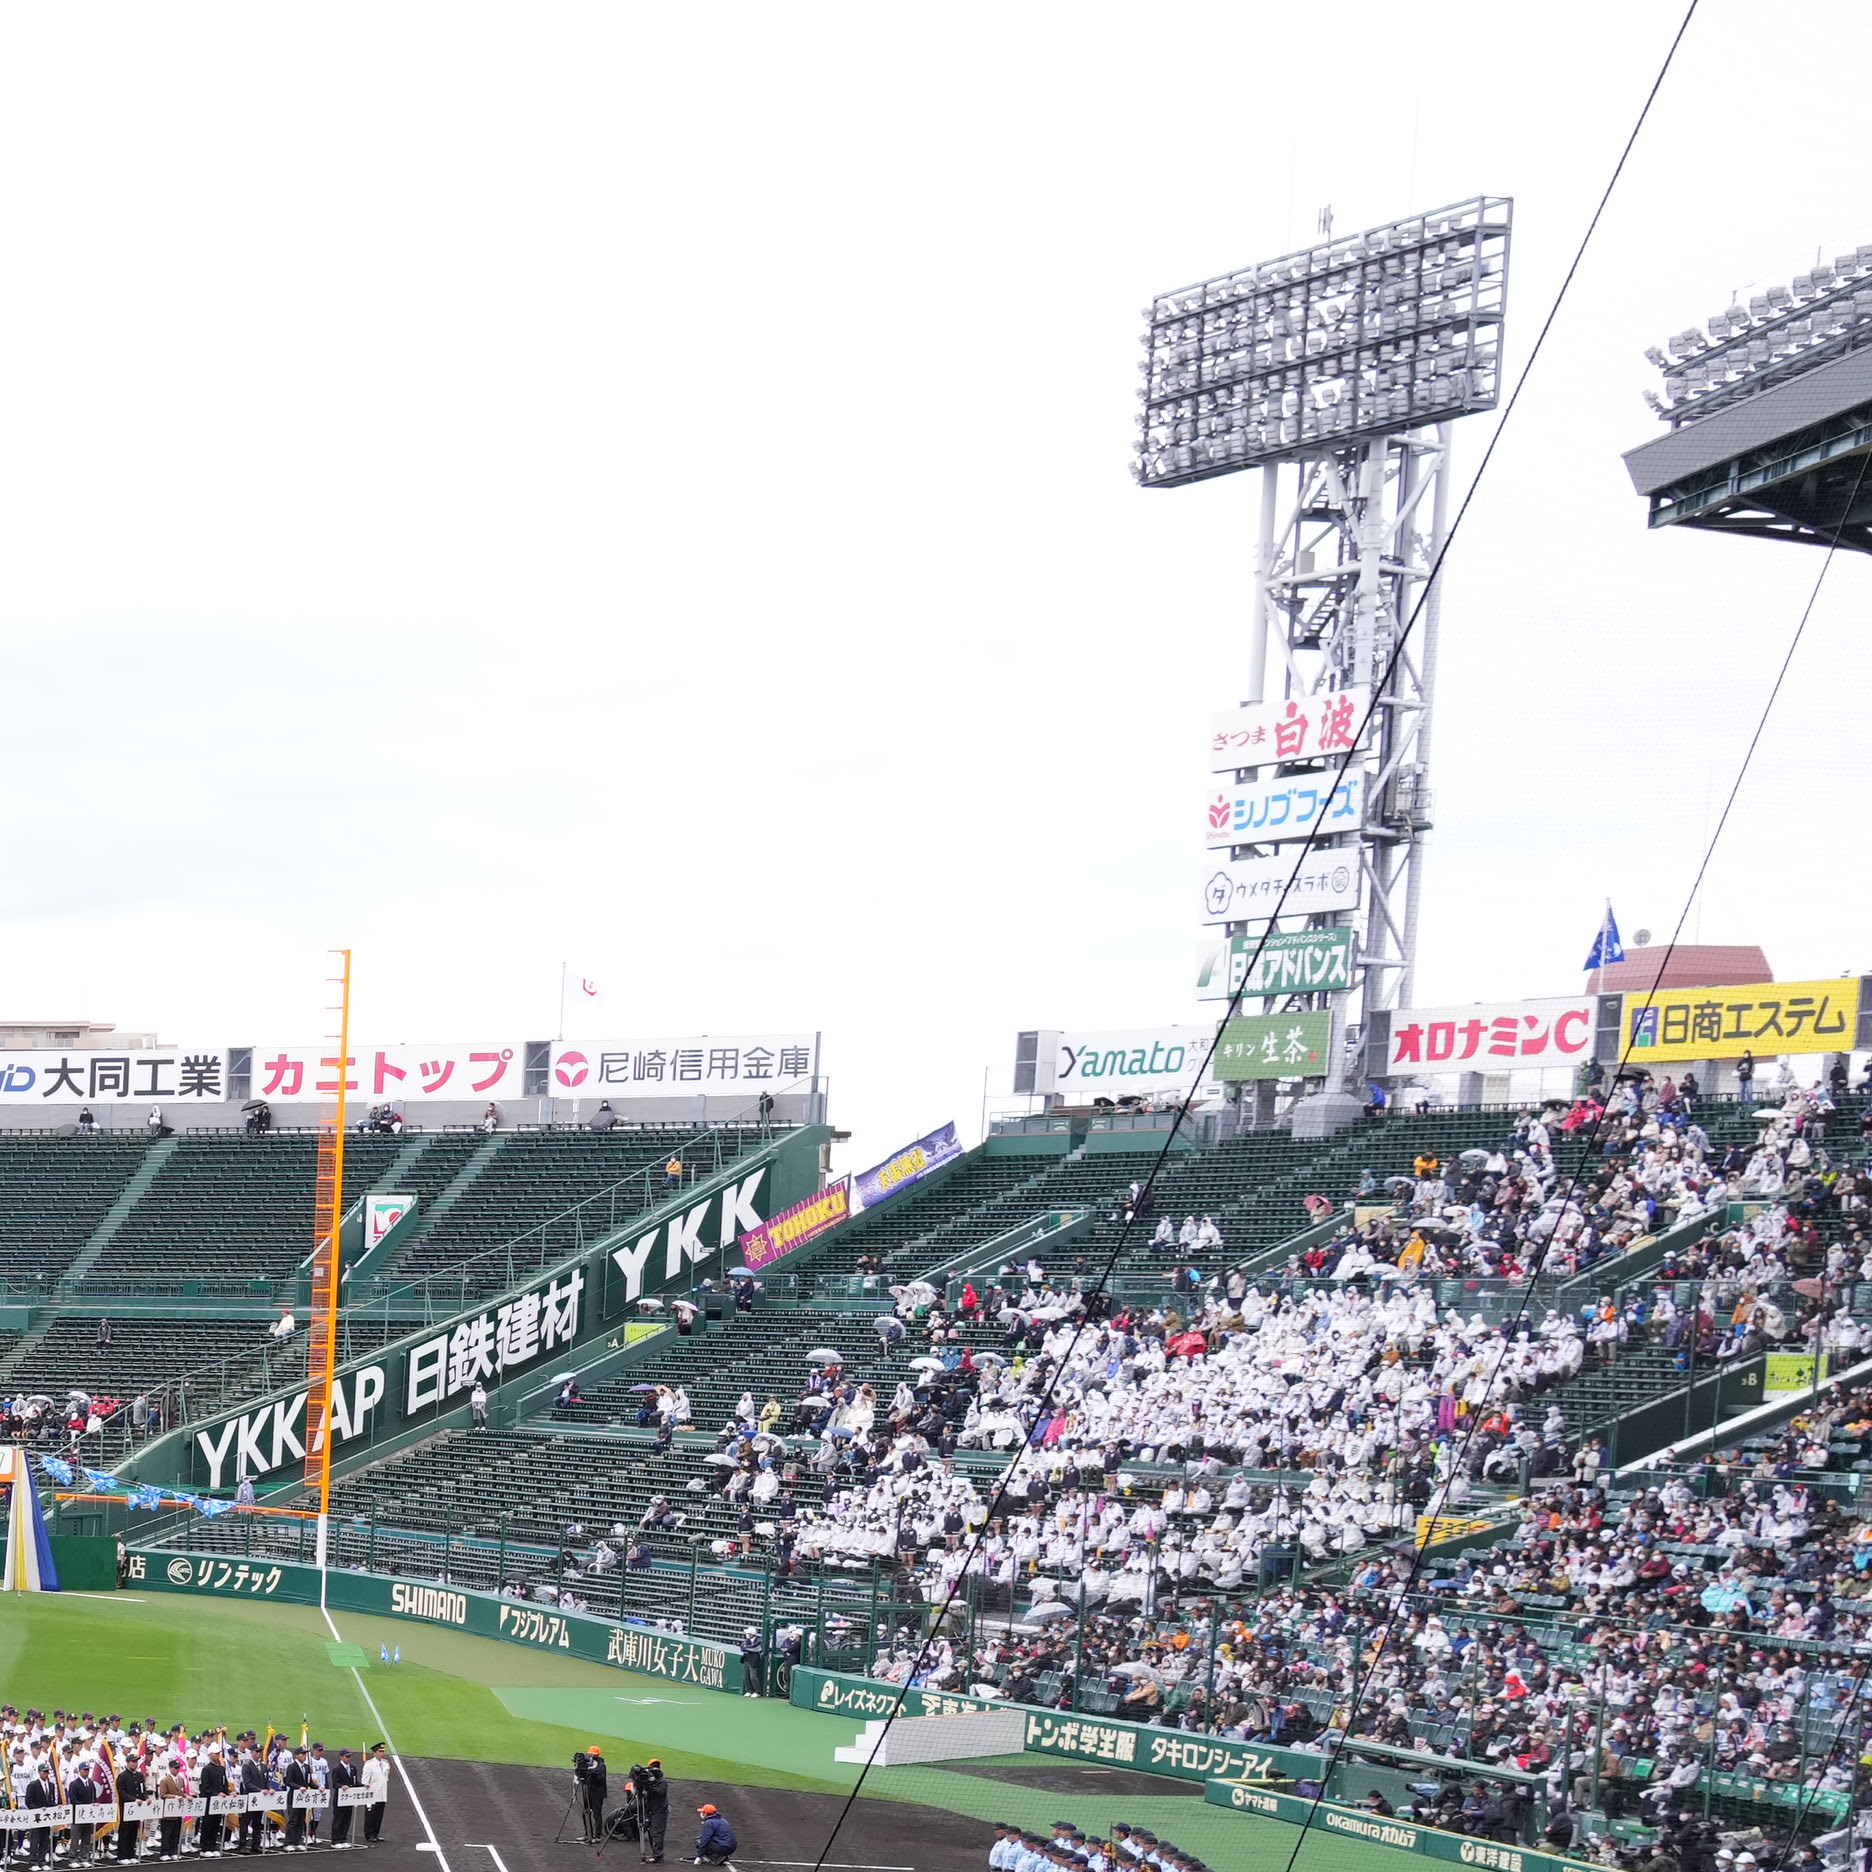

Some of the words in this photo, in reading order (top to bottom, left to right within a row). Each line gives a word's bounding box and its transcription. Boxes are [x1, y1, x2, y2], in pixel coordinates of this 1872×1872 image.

[1212, 726, 1266, 751] さつま
[1274, 694, 1355, 759] 白波
[1234, 780, 1358, 831] シノブフーズ
[1394, 1007, 1590, 1065] オロナミンC
[1662, 995, 1846, 1044] 日商エステム
[597, 1043, 810, 1085] 尼崎信用金庫
[1058, 1040, 1185, 1079] Yamato
[1223, 1043, 1255, 1059] キリン
[1260, 1025, 1309, 1065] 生茶
[42, 1053, 223, 1098] 大同工業
[261, 1047, 514, 1096] カニトップ
[610, 1167, 768, 1304] YKK
[768, 1190, 849, 1250] TOHOKU
[406, 1268, 584, 1416] 日鉄建材
[197, 1559, 283, 1594] リンテック
[391, 1583, 467, 1625] SHIMANO
[509, 1607, 570, 1649] フジプレアム
[607, 1628, 699, 1683] 武庫川女子大
[699, 1647, 725, 1670] MUKO
[699, 1665, 724, 1690] GAWA
[834, 1683, 907, 1719] レイズネクスト
[1028, 1715, 1137, 1763] トンボ学生服
[1150, 1736, 1275, 1780] タキロンシーアイ
[1326, 1811, 1380, 1839] Okamura
[1380, 1824, 1417, 1848] オカムラ
[1474, 1847, 1523, 1872] 東洋建設
